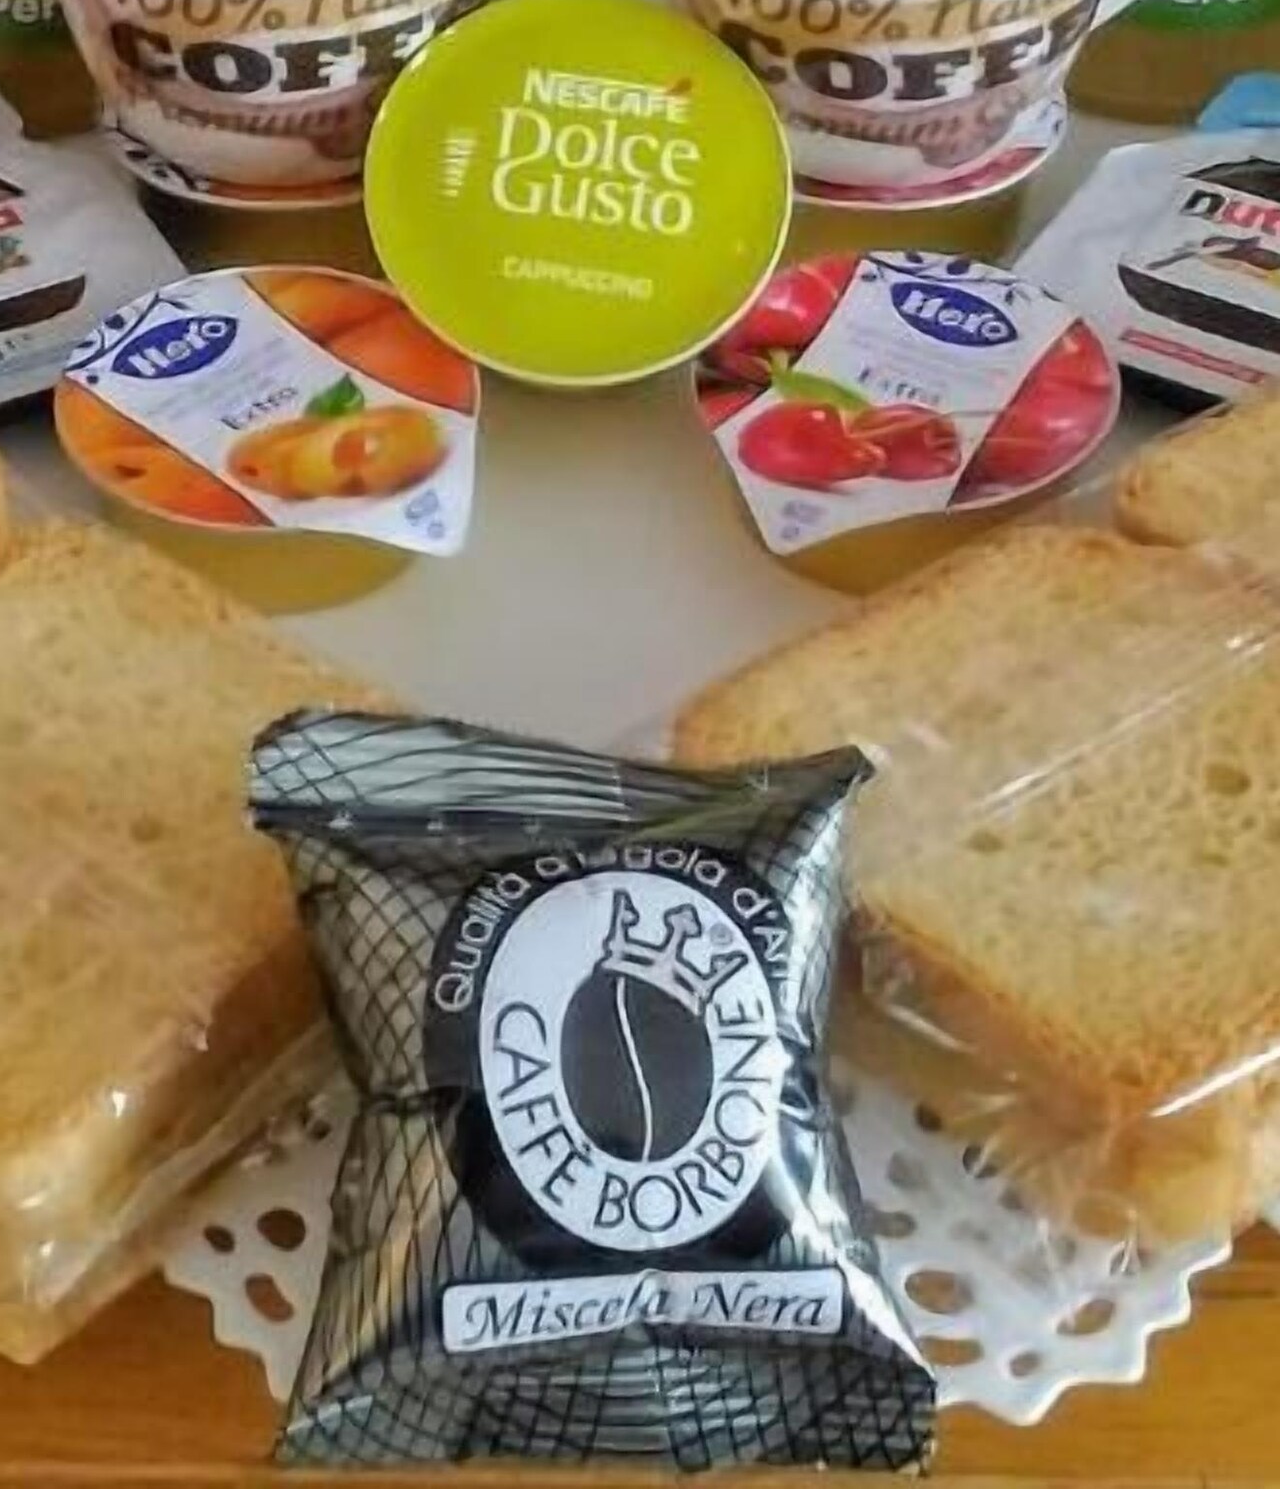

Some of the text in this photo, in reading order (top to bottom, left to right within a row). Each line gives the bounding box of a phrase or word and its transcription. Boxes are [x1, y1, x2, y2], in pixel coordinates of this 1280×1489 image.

[495, 106, 701, 186] Dolce
[492, 156, 694, 236] Gusto
[502, 256, 654, 301] CAPPUCCINO
[900, 289, 1011, 341] Hero
[125, 317, 229, 376] Hero
[493, 997, 774, 1234] CAFFÈ BORBONE
[461, 1273, 829, 1346] Miscela Nera
